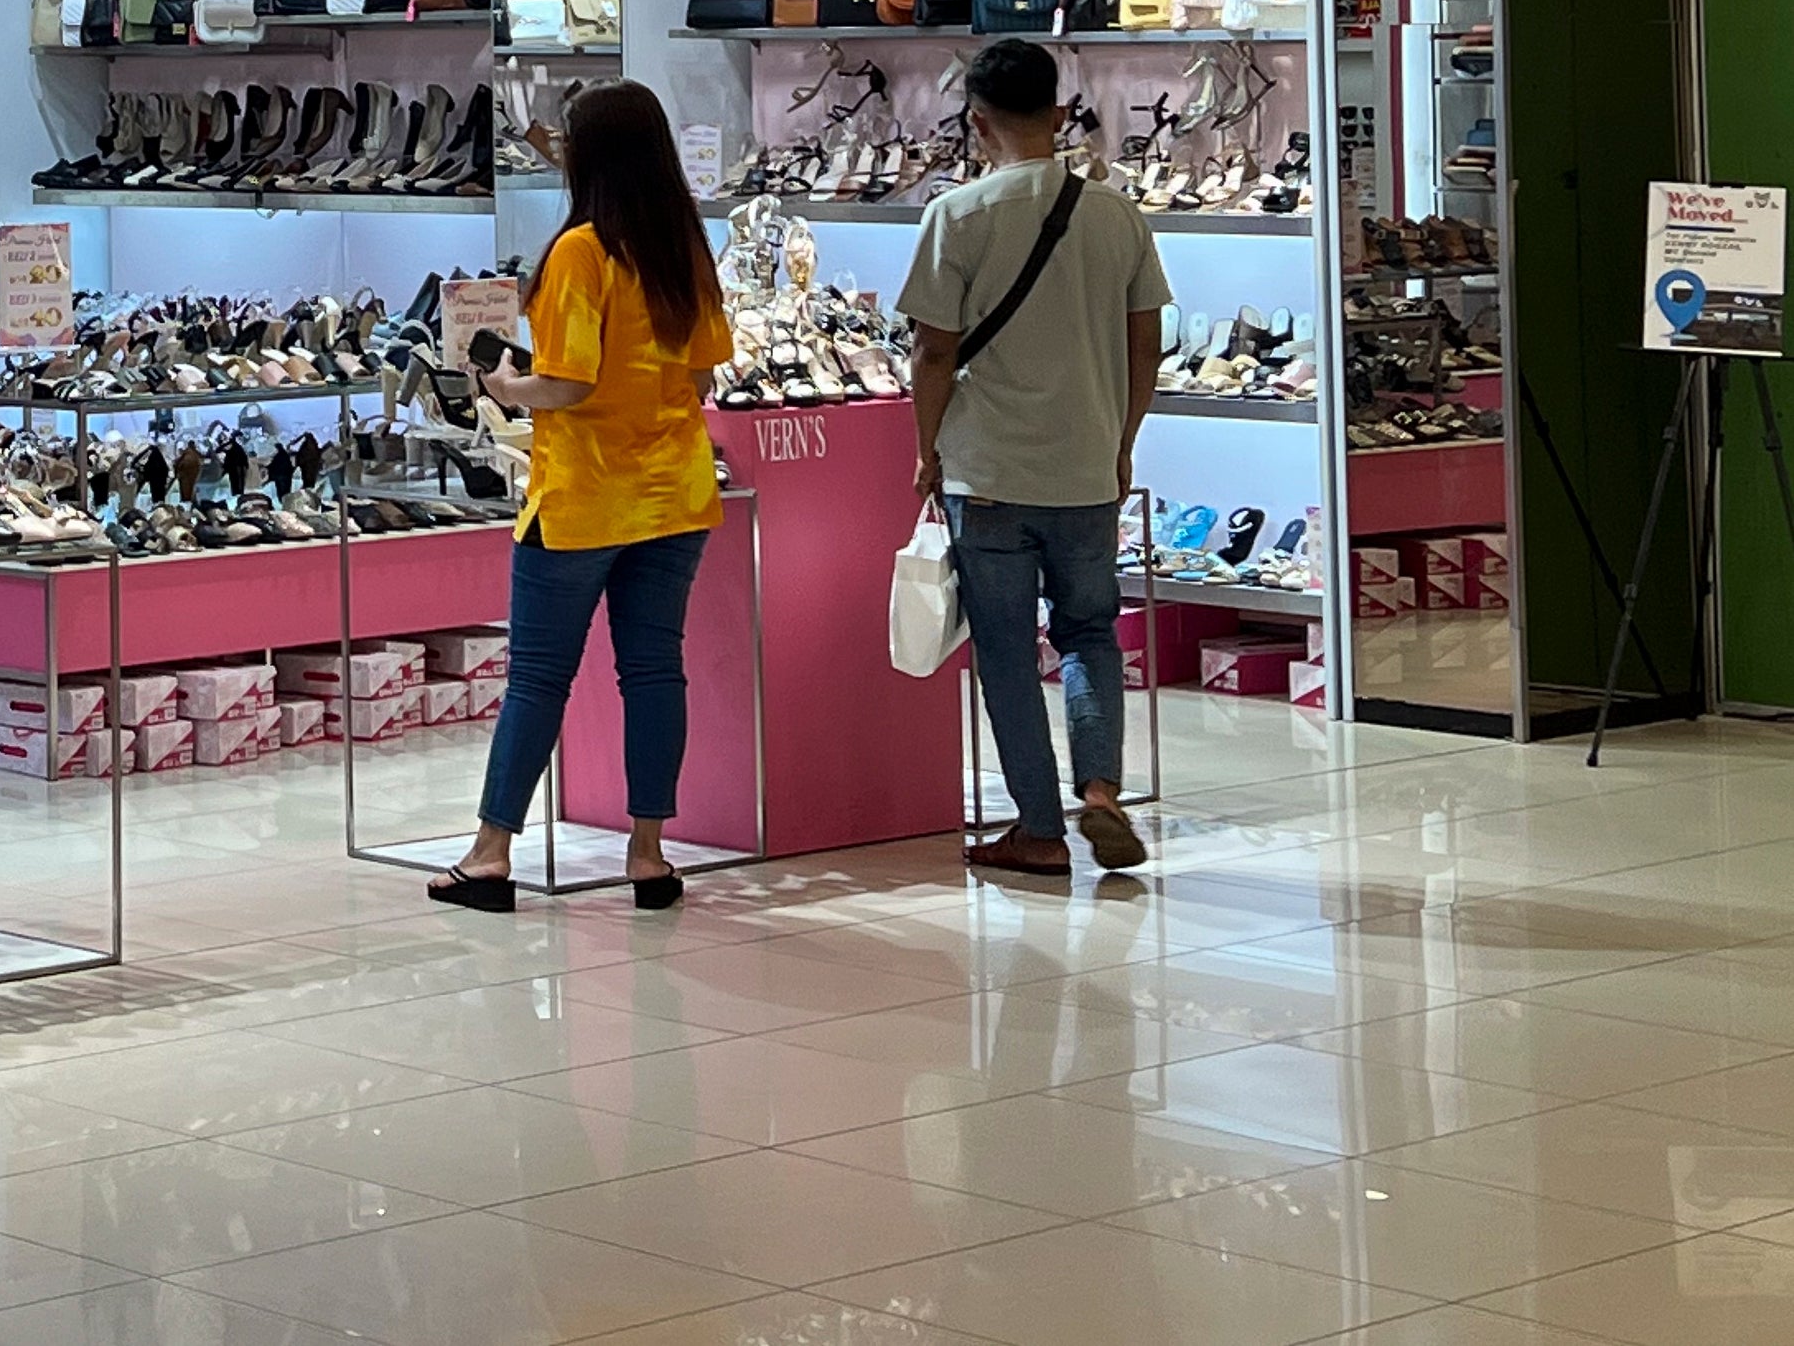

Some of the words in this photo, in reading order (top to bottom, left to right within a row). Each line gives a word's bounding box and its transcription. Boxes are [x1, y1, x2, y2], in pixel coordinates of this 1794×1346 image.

[1667, 191, 1726, 209] We've
[1667, 205, 1734, 223] Moved
[753, 414, 827, 463] VERN'S
